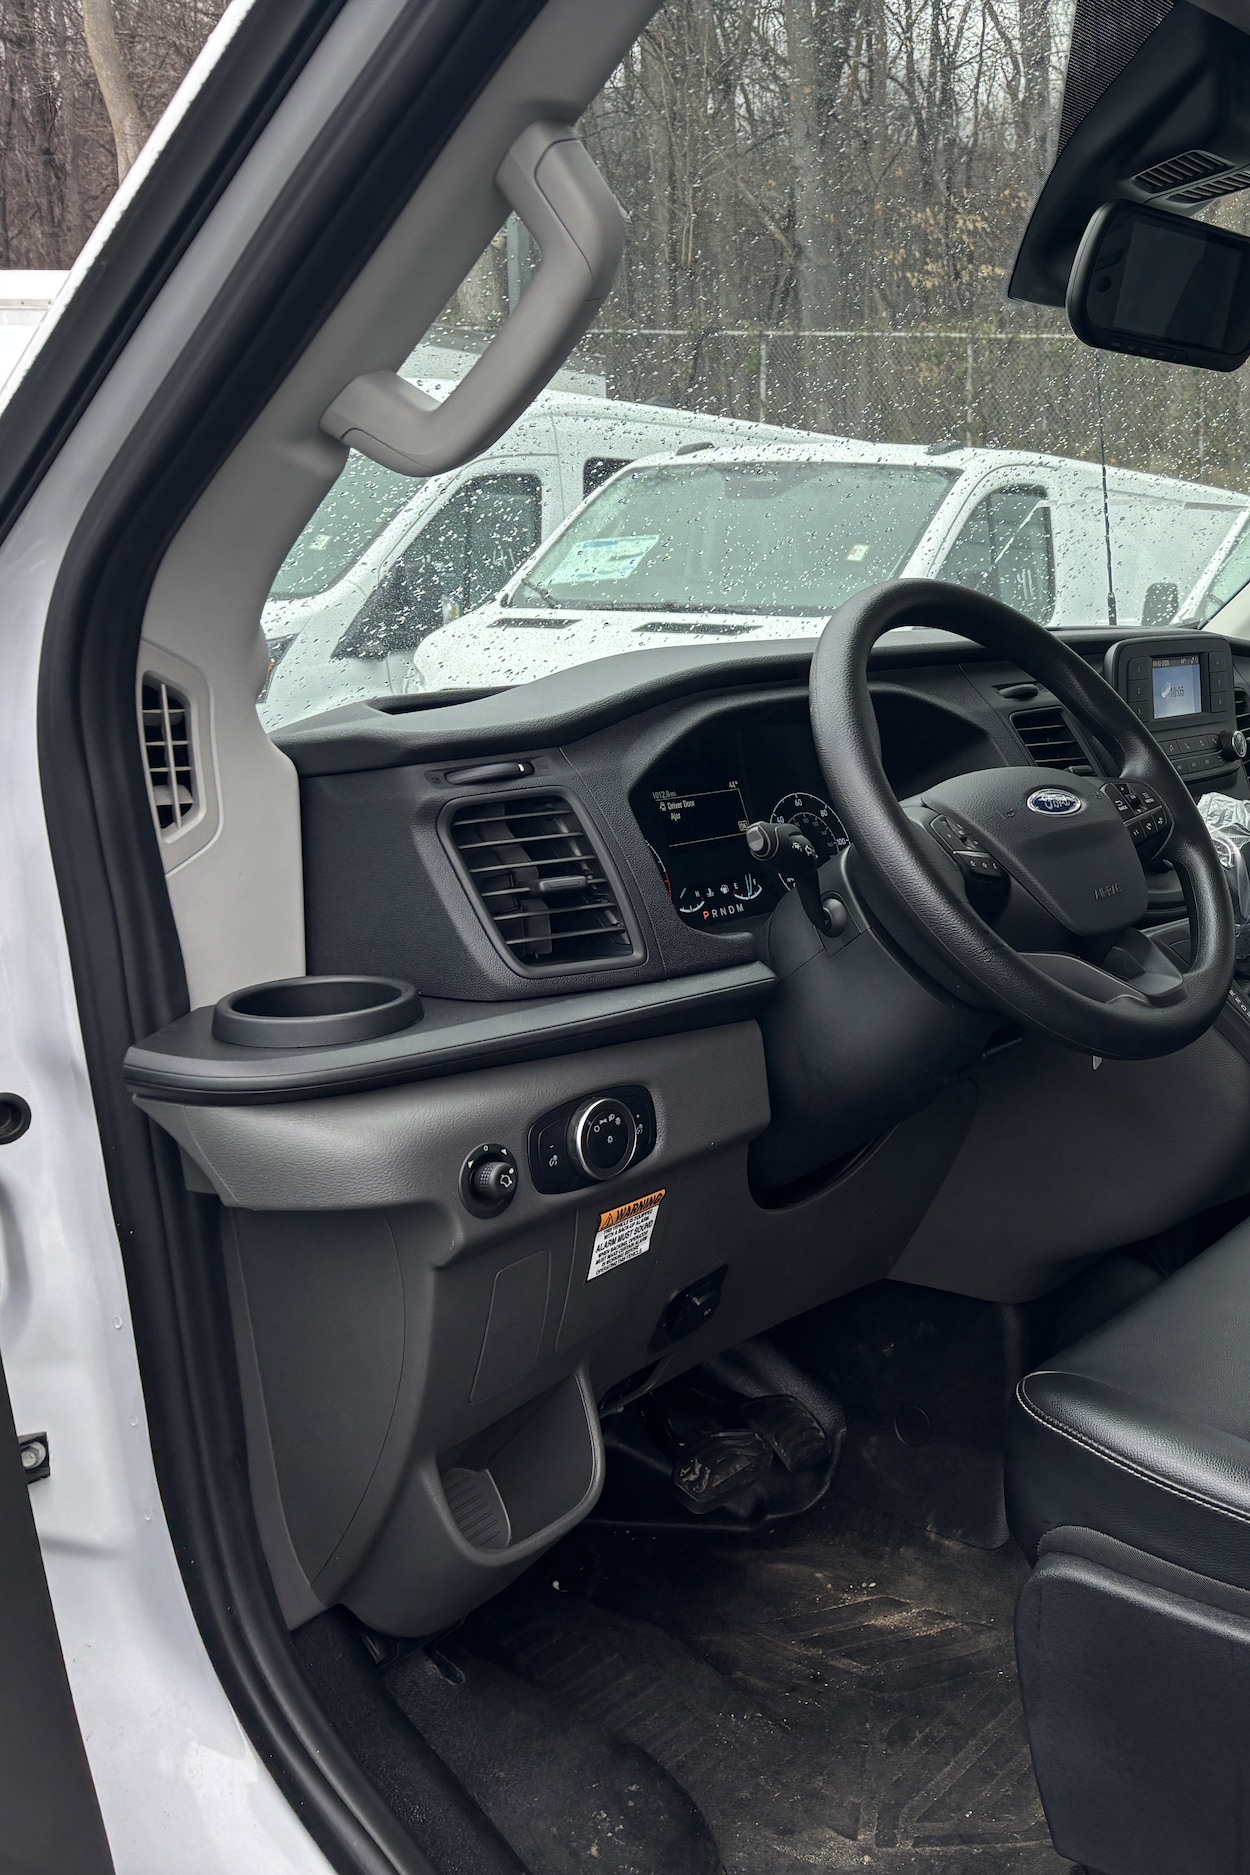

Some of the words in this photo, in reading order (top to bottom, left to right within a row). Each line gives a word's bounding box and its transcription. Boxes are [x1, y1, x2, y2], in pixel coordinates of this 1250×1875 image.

[683, 799, 696, 808] Door
[794, 798, 803, 807] 60
[819, 809, 828, 817] 80
[616, 1193, 663, 1222] WARNING
[595, 1235, 617, 1253] ALARM
[616, 1228, 633, 1243] MUST
[633, 1218, 654, 1235] SOUND
